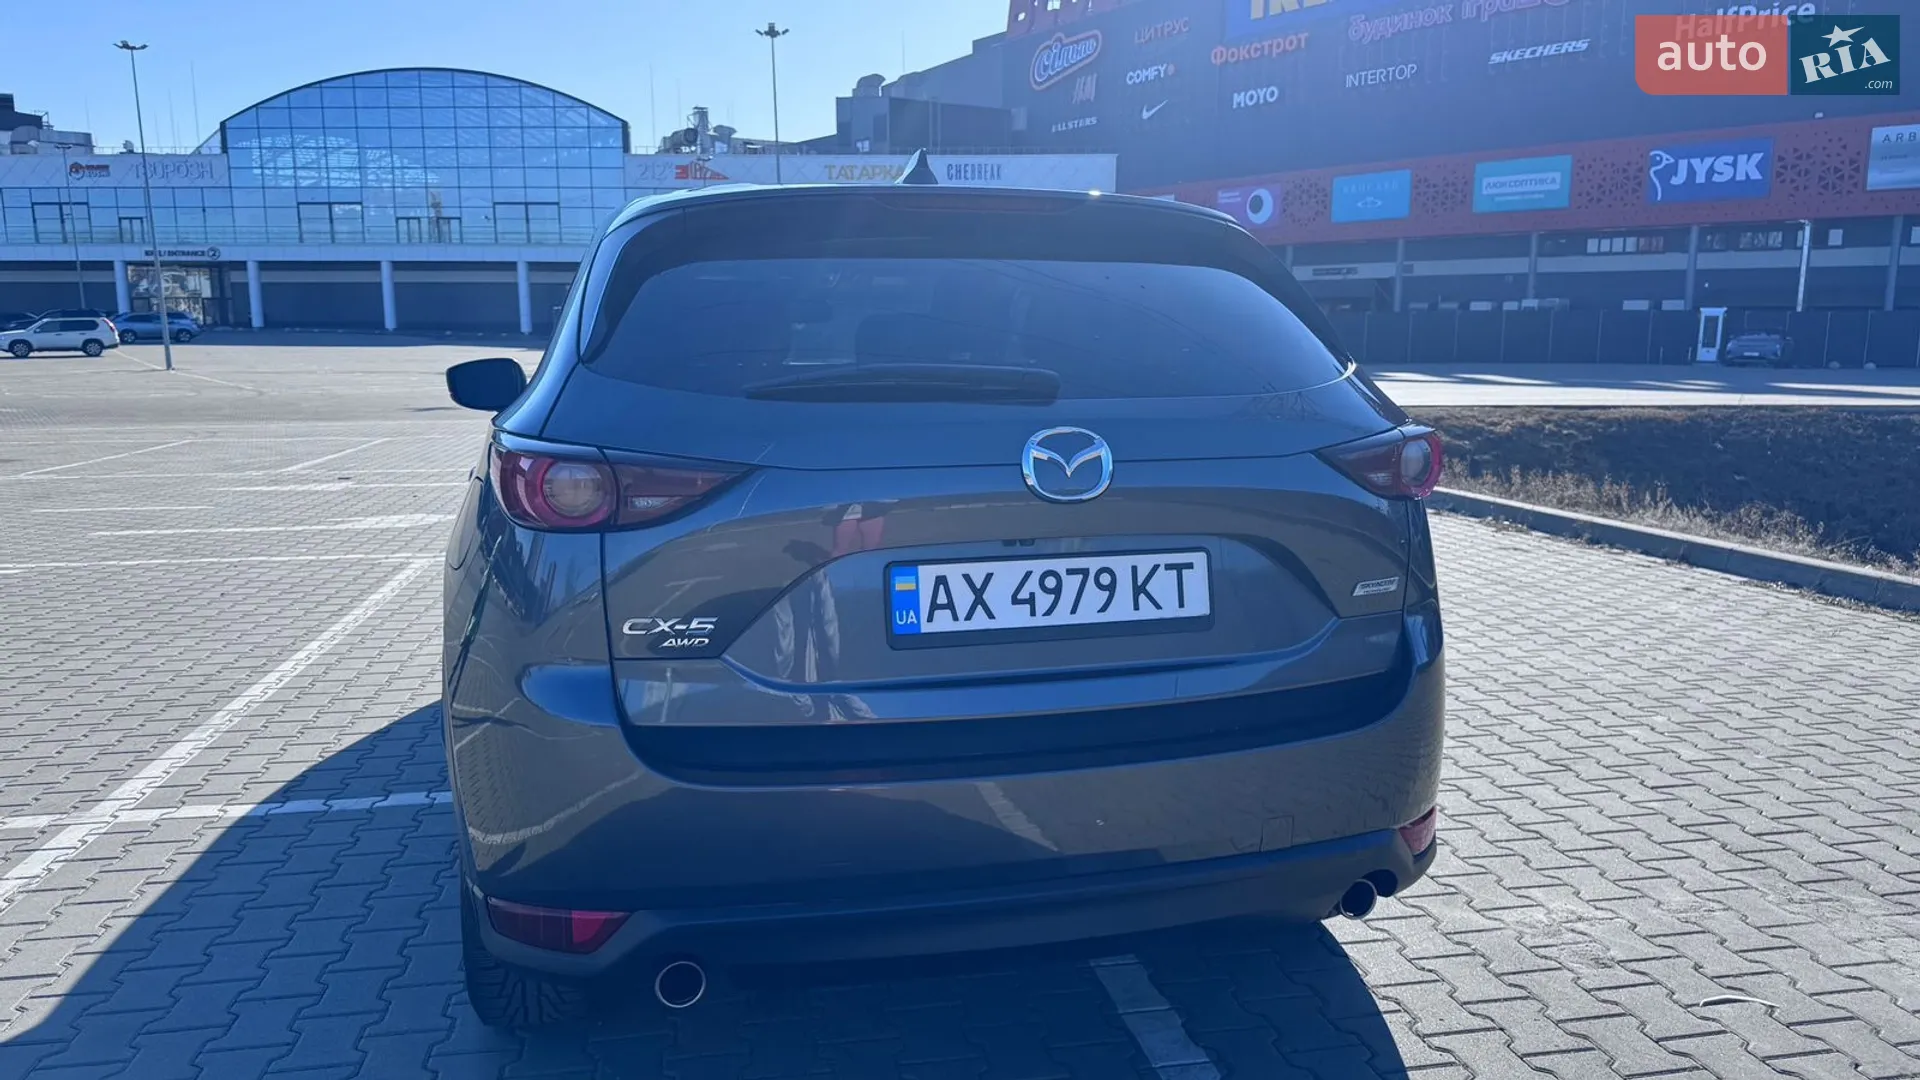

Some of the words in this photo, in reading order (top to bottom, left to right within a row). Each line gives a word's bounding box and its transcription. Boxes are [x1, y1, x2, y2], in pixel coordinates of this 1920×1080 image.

[1134, 17, 1190, 44] ЦИТРУС
[1348, 5, 1453, 44] будинок
[1210, 32, 1309, 66] Фокстрот
[1488, 39, 1592, 64] SKECHERS
[1126, 64, 1167, 85] COMFY
[1345, 63, 1418, 88] INTERTOP
[1232, 86, 1279, 109] MOYO
[1669, 152, 1765, 185] JYSK
[926, 573, 996, 622] AX
[1011, 566, 1118, 617] 4979
[1131, 562, 1195, 611] KT
[622, 617, 719, 635] CX-5
[896, 610, 917, 625] UA
[658, 638, 711, 648] AWD
